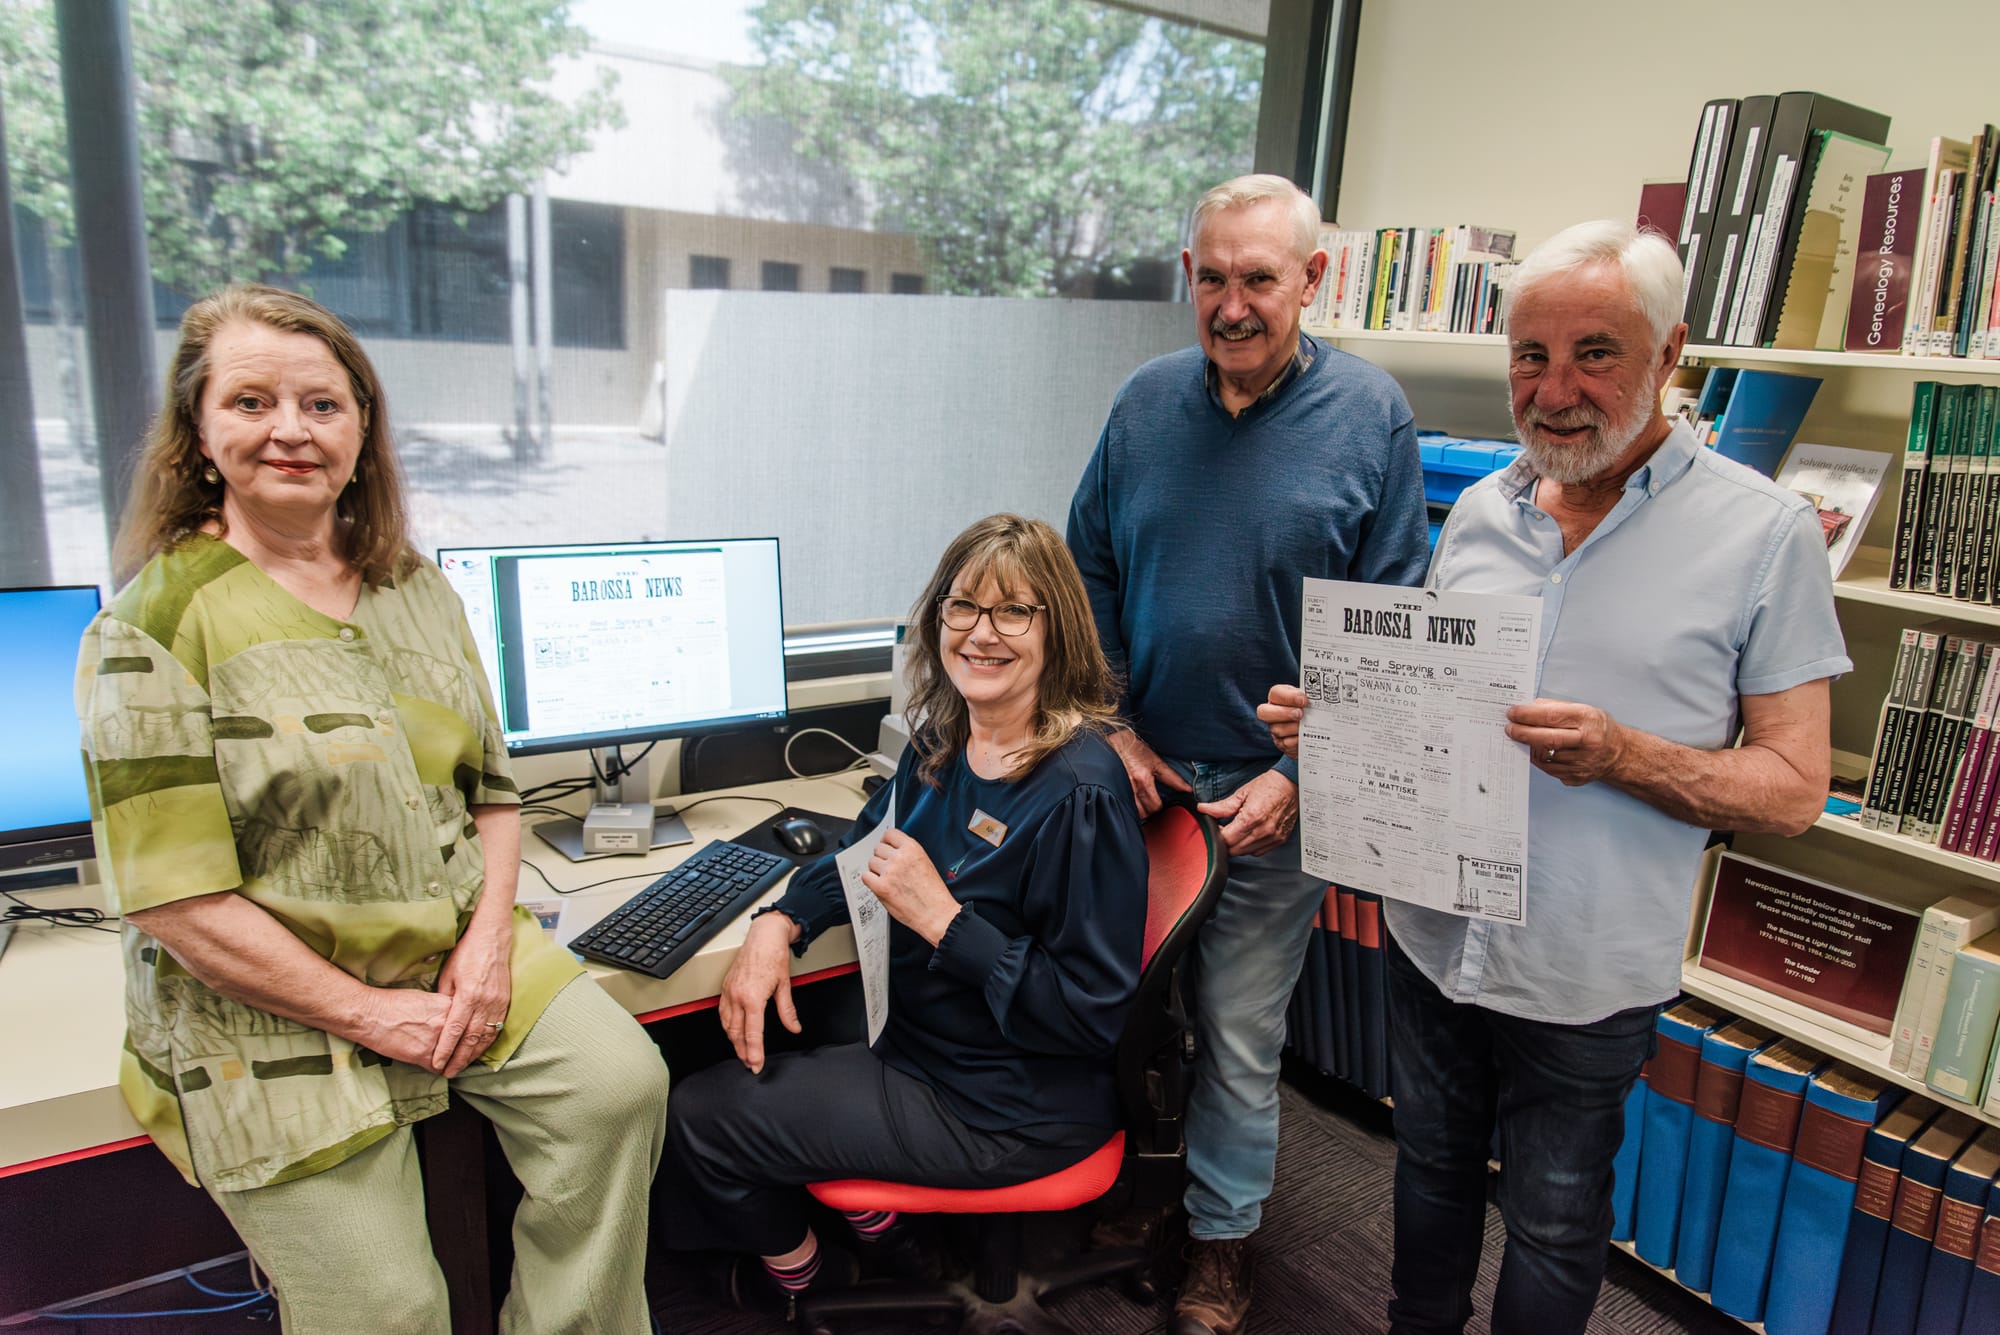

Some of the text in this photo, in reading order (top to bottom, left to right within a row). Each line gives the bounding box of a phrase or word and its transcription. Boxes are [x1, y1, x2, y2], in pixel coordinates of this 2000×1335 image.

[1867, 175, 1904, 346] Genealogy Resources
[1358, 259, 1366, 283] PIPES
[1357, 284, 1362, 295] OF
[1833, 461, 1865, 473] riddles
[1909, 470, 1918, 482] Index
[1933, 472, 1941, 483] Index
[1972, 474, 1981, 485] Index
[1903, 488, 1916, 523] Registrations
[1927, 489, 1940, 524] Registrations
[1965, 491, 1979, 528] Registrations
[1944, 474, 1962, 563] Index Registrations 1842 1906
[1980, 474, 1999, 567] Index Registrations 1842 1906
[1902, 527, 1912, 540] 1842
[1926, 529, 1935, 541] 1842
[1965, 533, 1974, 545] 1842
[1899, 546, 1909, 560] 1906
[1923, 547, 1932, 561] 1906
[1962, 552, 1971, 565] 1906
[571, 576, 683, 601] BAROSSA NEWS
[1393, 603, 1422, 612] THE
[1343, 607, 1412, 640] BAROSSA
[1426, 615, 1476, 646] NEWS
[1360, 656, 1458, 677] Red Spraying Oil
[1955, 663, 1967, 689] Australian
[1359, 678, 1421, 695] SWANN & CO.
[1973, 666, 1986, 692] Australian
[1362, 693, 1416, 707] ANGASTON
[1950, 690, 1961, 709] Deaths
[1969, 692, 1979, 712] Deaths
[1982, 694, 1993, 713] Deaths
[1875, 653, 1908, 777] Australian Deaths Index of Registrations 1842
[1894, 656, 1928, 782] Australian Deaths Index of Registrations 1842
[1916, 659, 1950, 784] Australian Deaths Index of Registrations 1842
[1944, 721, 1953, 734] Index
[1974, 728, 1984, 741] Index
[1933, 743, 1948, 776] Registrations
[1963, 750, 1978, 779] Registrations
[1982, 752, 1996, 783] Registrations
[1930, 777, 1939, 790] 1842
[1362, 816, 1388, 825] ARTIFICIAL
[1988, 821, 1997, 830] Vol
[1471, 861, 1519, 873] METTERS
[1745, 878, 1893, 931] Newspapers listed below are in storage
[1774, 897, 1856, 929] and readily available
[1756, 901, 1873, 945] Please enquire with library staff
[1766, 923, 1779, 932] The
[1778, 927, 1805, 941] Barossa
[1812, 938, 1830, 951] Light
[1828, 944, 1852, 957] Herald
[1783, 957, 1821, 976] The Leader
[1785, 968, 1816, 984] 1977-1980
